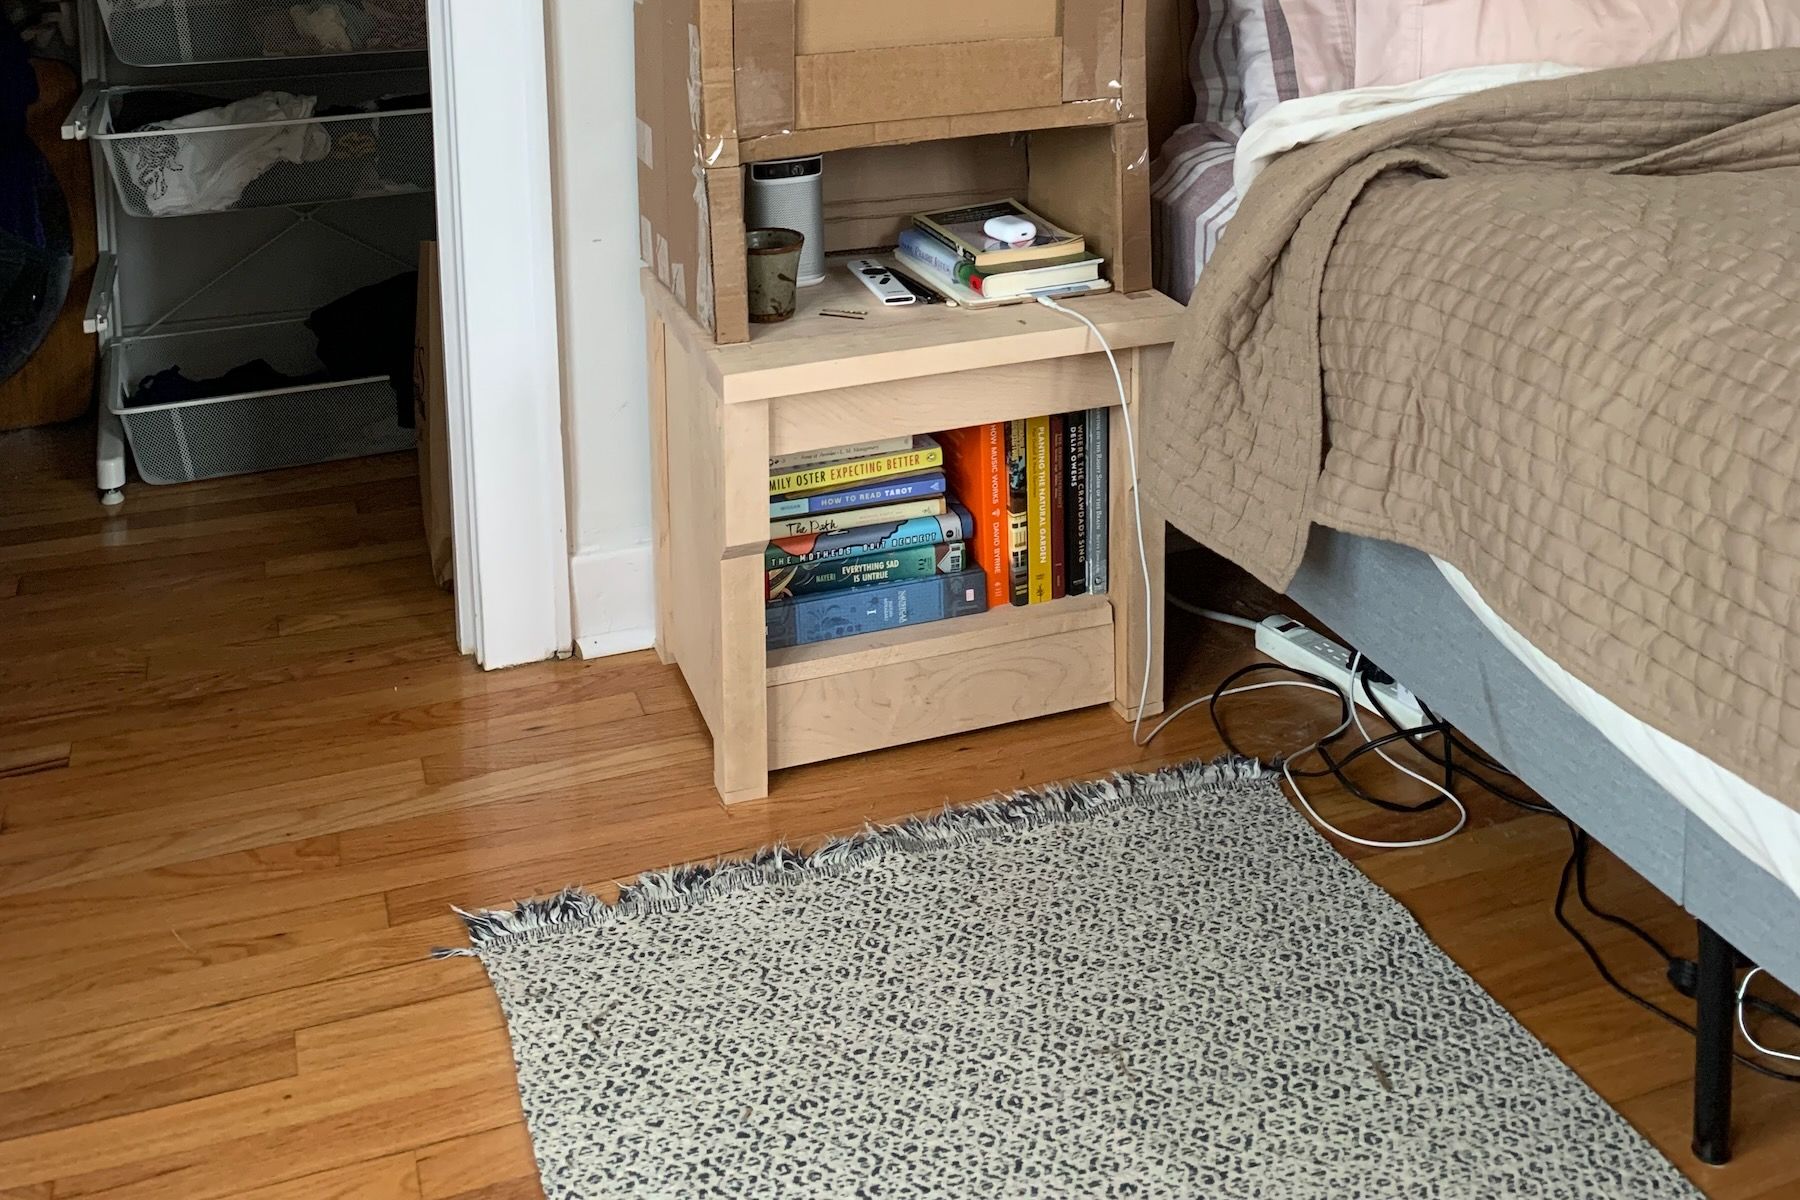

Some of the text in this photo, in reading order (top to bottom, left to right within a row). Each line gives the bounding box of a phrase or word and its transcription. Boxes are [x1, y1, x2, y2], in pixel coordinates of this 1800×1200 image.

[990, 424, 998, 445] HOW
[830, 454, 920, 481] EXPECTING BETTER
[991, 446, 999, 473] MUSIC
[769, 472, 826, 491] MILY OSTER
[821, 498, 842, 506] HOW
[859, 491, 882, 500] READ
[884, 487, 913, 496] TAROT
[1039, 487, 1047, 526] NATURAL
[786, 519, 838, 536] The Path
[892, 532, 937, 547] BENNETT
[772, 547, 851, 566] THE MOTHERS
[1078, 540, 1086, 563] SING
[842, 560, 900, 575] EVERYTHING SAD
[853, 571, 889, 583] IS UNTRUE
